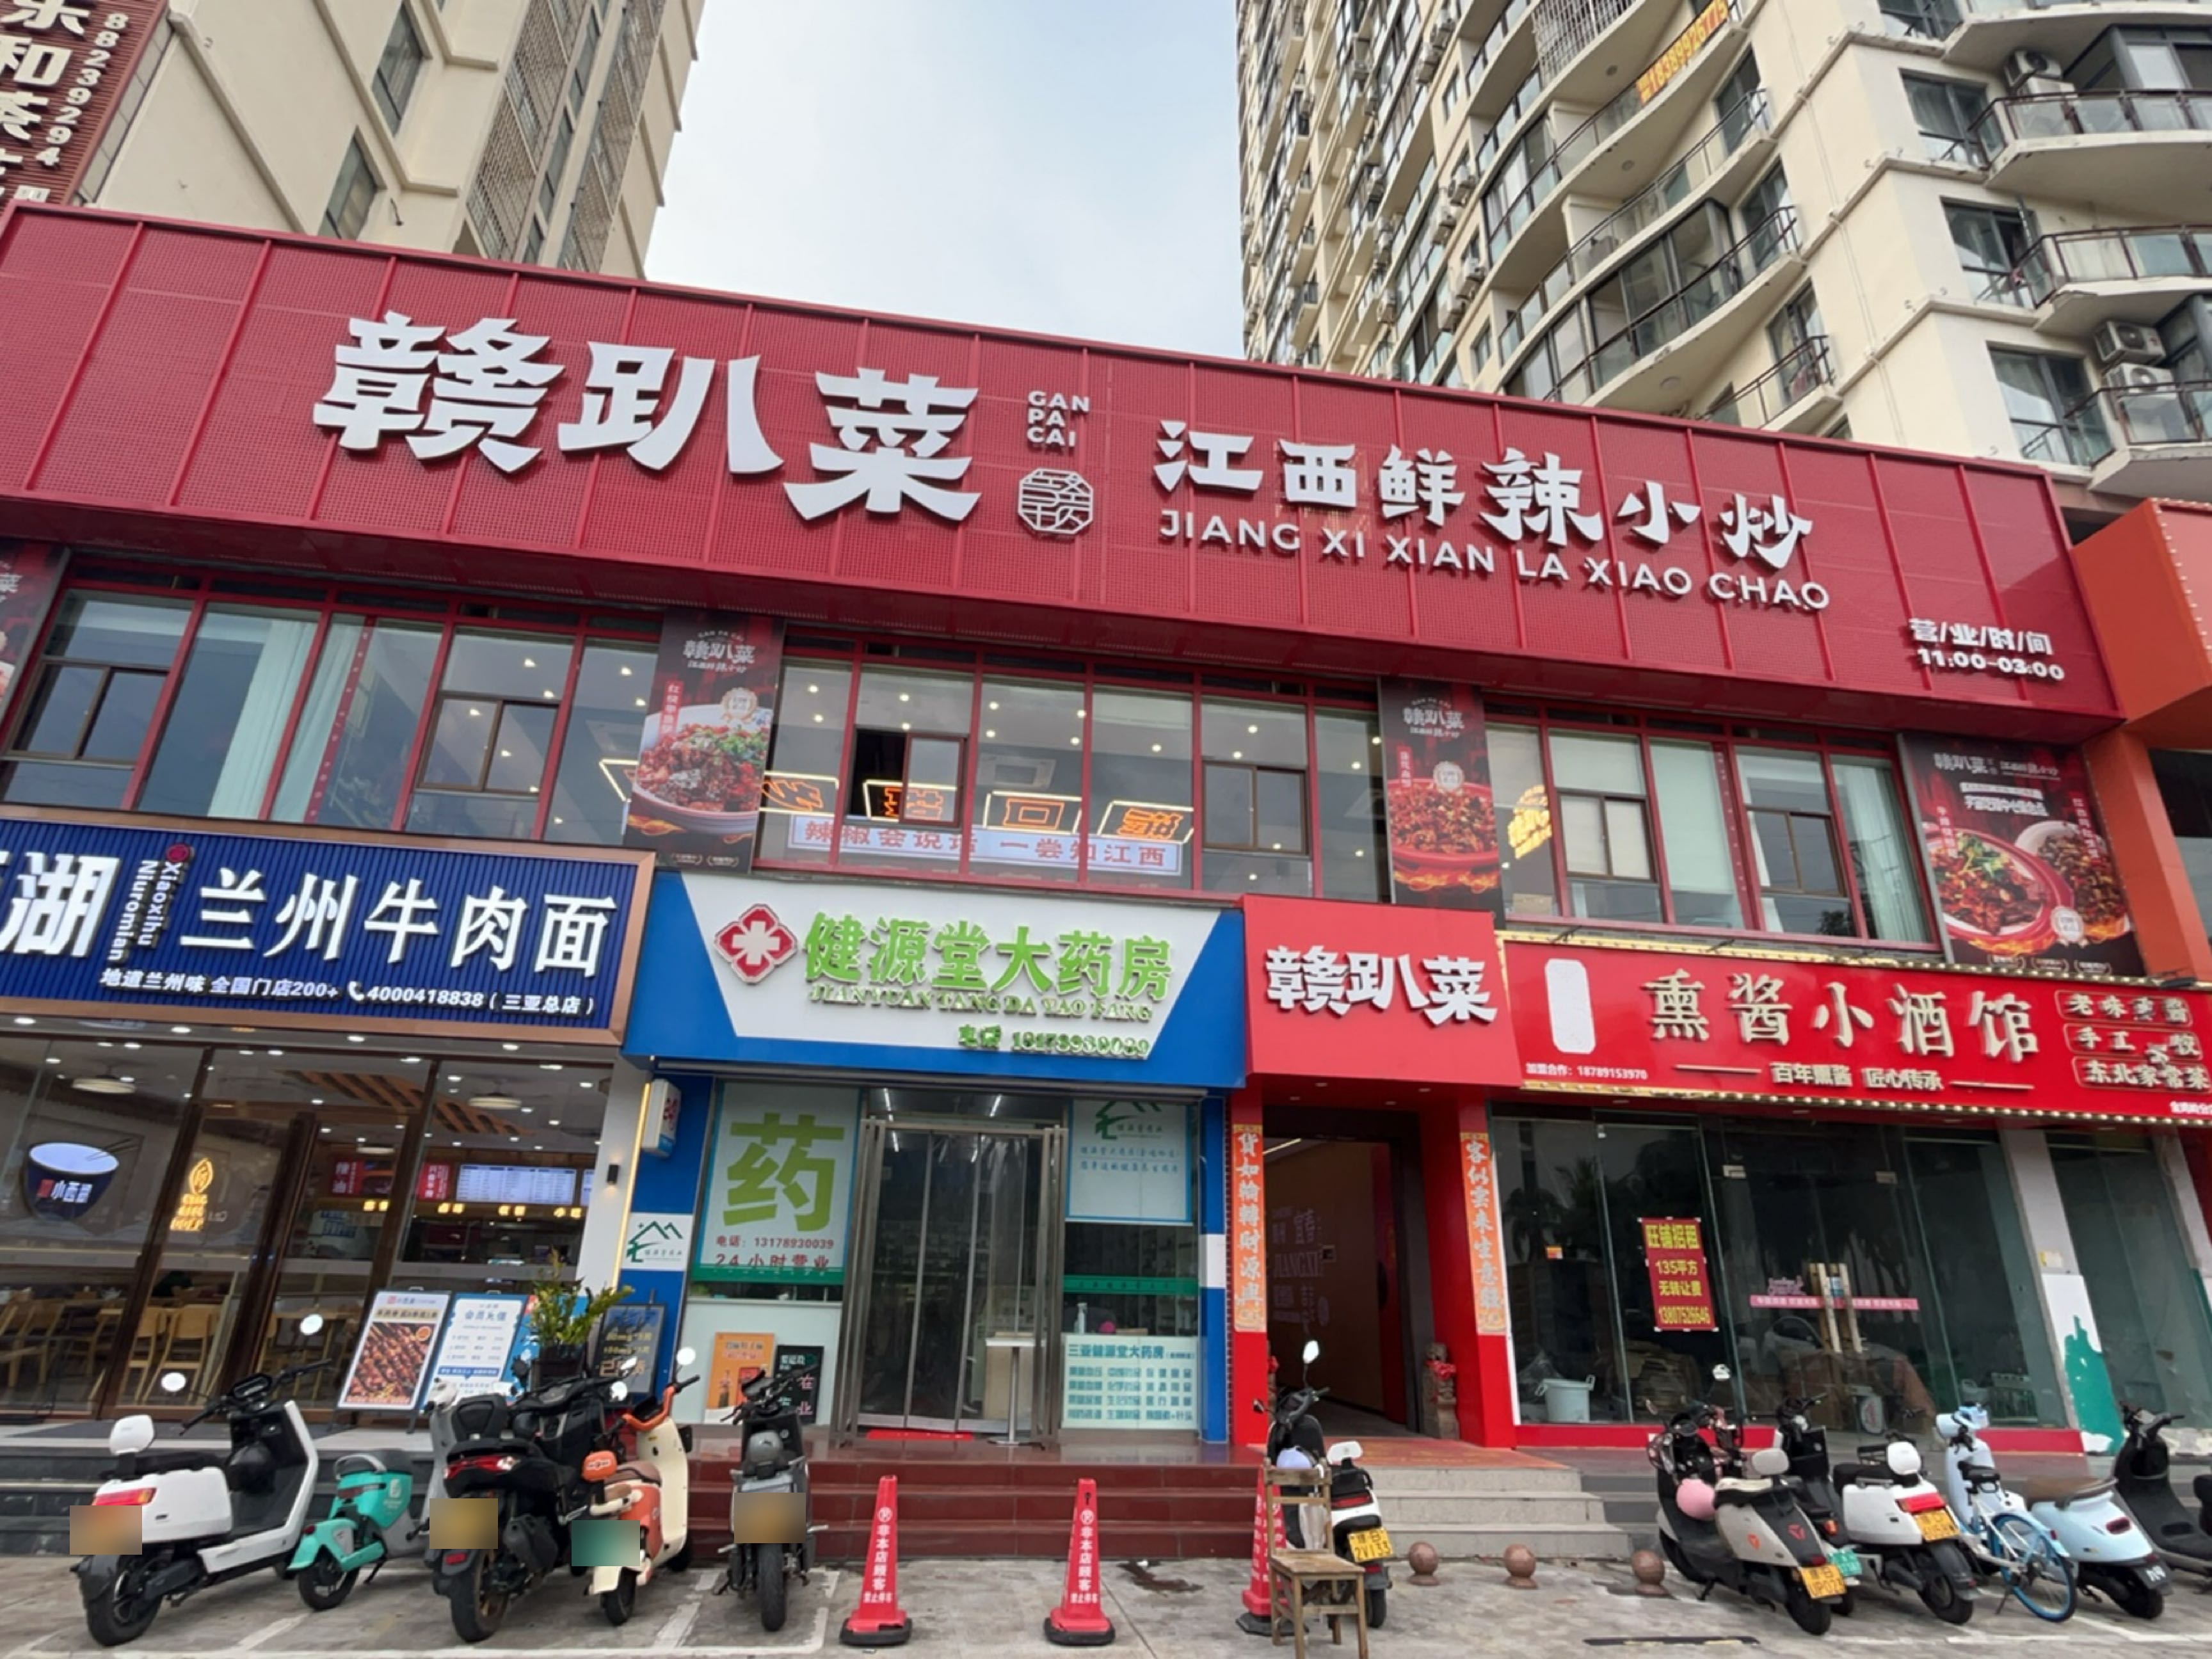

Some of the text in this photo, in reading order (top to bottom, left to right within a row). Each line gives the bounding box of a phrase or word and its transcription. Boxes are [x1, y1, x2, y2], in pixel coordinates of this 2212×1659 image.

[35, 13, 129, 166] 88239294
[313, 311, 982, 522] 赣趴菜
[1027, 427, 1076, 447] CAI
[1028, 391, 1090, 412] GAN
[1028, 408, 1066, 428] PA
[1154, 420, 1813, 570] 江西鲜辣小炒
[1160, 510, 1831, 610] JIANG XI XIAN LA XIAO CHAO
[0, 851, 120, 956] 湖
[180, 867, 617, 977] 兰州牛肉面
[100, 968, 207, 993] 地道兰州味
[803, 911, 1173, 1002] 健源堂大药房
[1265, 945, 1498, 1026] 赣趴菜
[1641, 968, 2039, 1062] 熏酱小酒馆
[723, 1112, 845, 1232] 药
